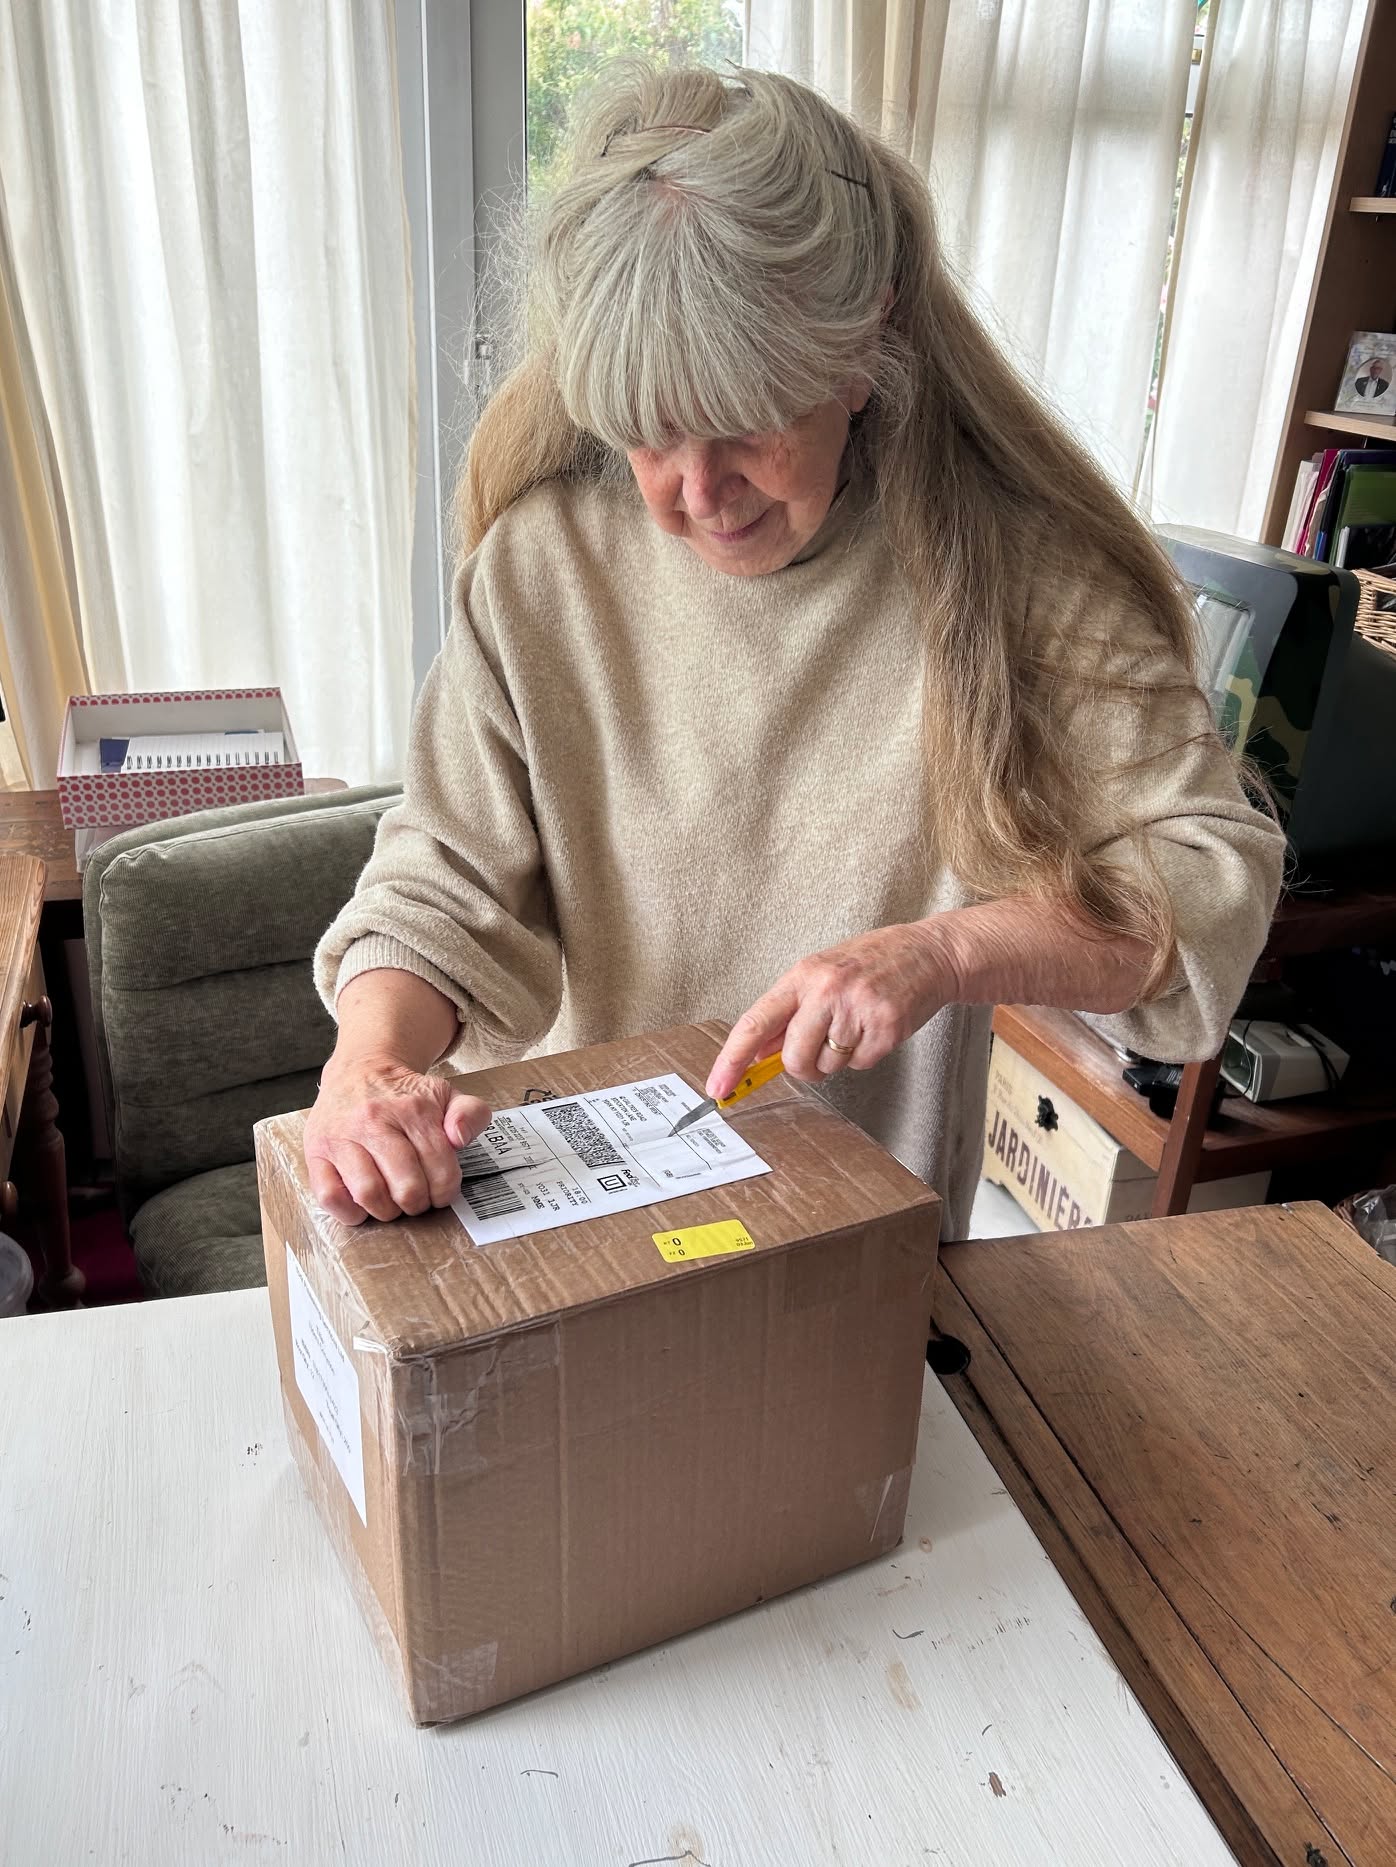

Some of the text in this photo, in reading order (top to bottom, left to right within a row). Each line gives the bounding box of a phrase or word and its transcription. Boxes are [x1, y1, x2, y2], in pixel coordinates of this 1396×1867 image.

[484, 1130, 512, 1155] LBAA
[988, 1109, 1093, 1229] JARDINIÈR
[536, 1181, 560, 1211] YO31 1JR
[556, 1180, 579, 1206] PRIORITY
[572, 1187, 589, 1204] 18:00
[672, 1237, 682, 1246] 0
